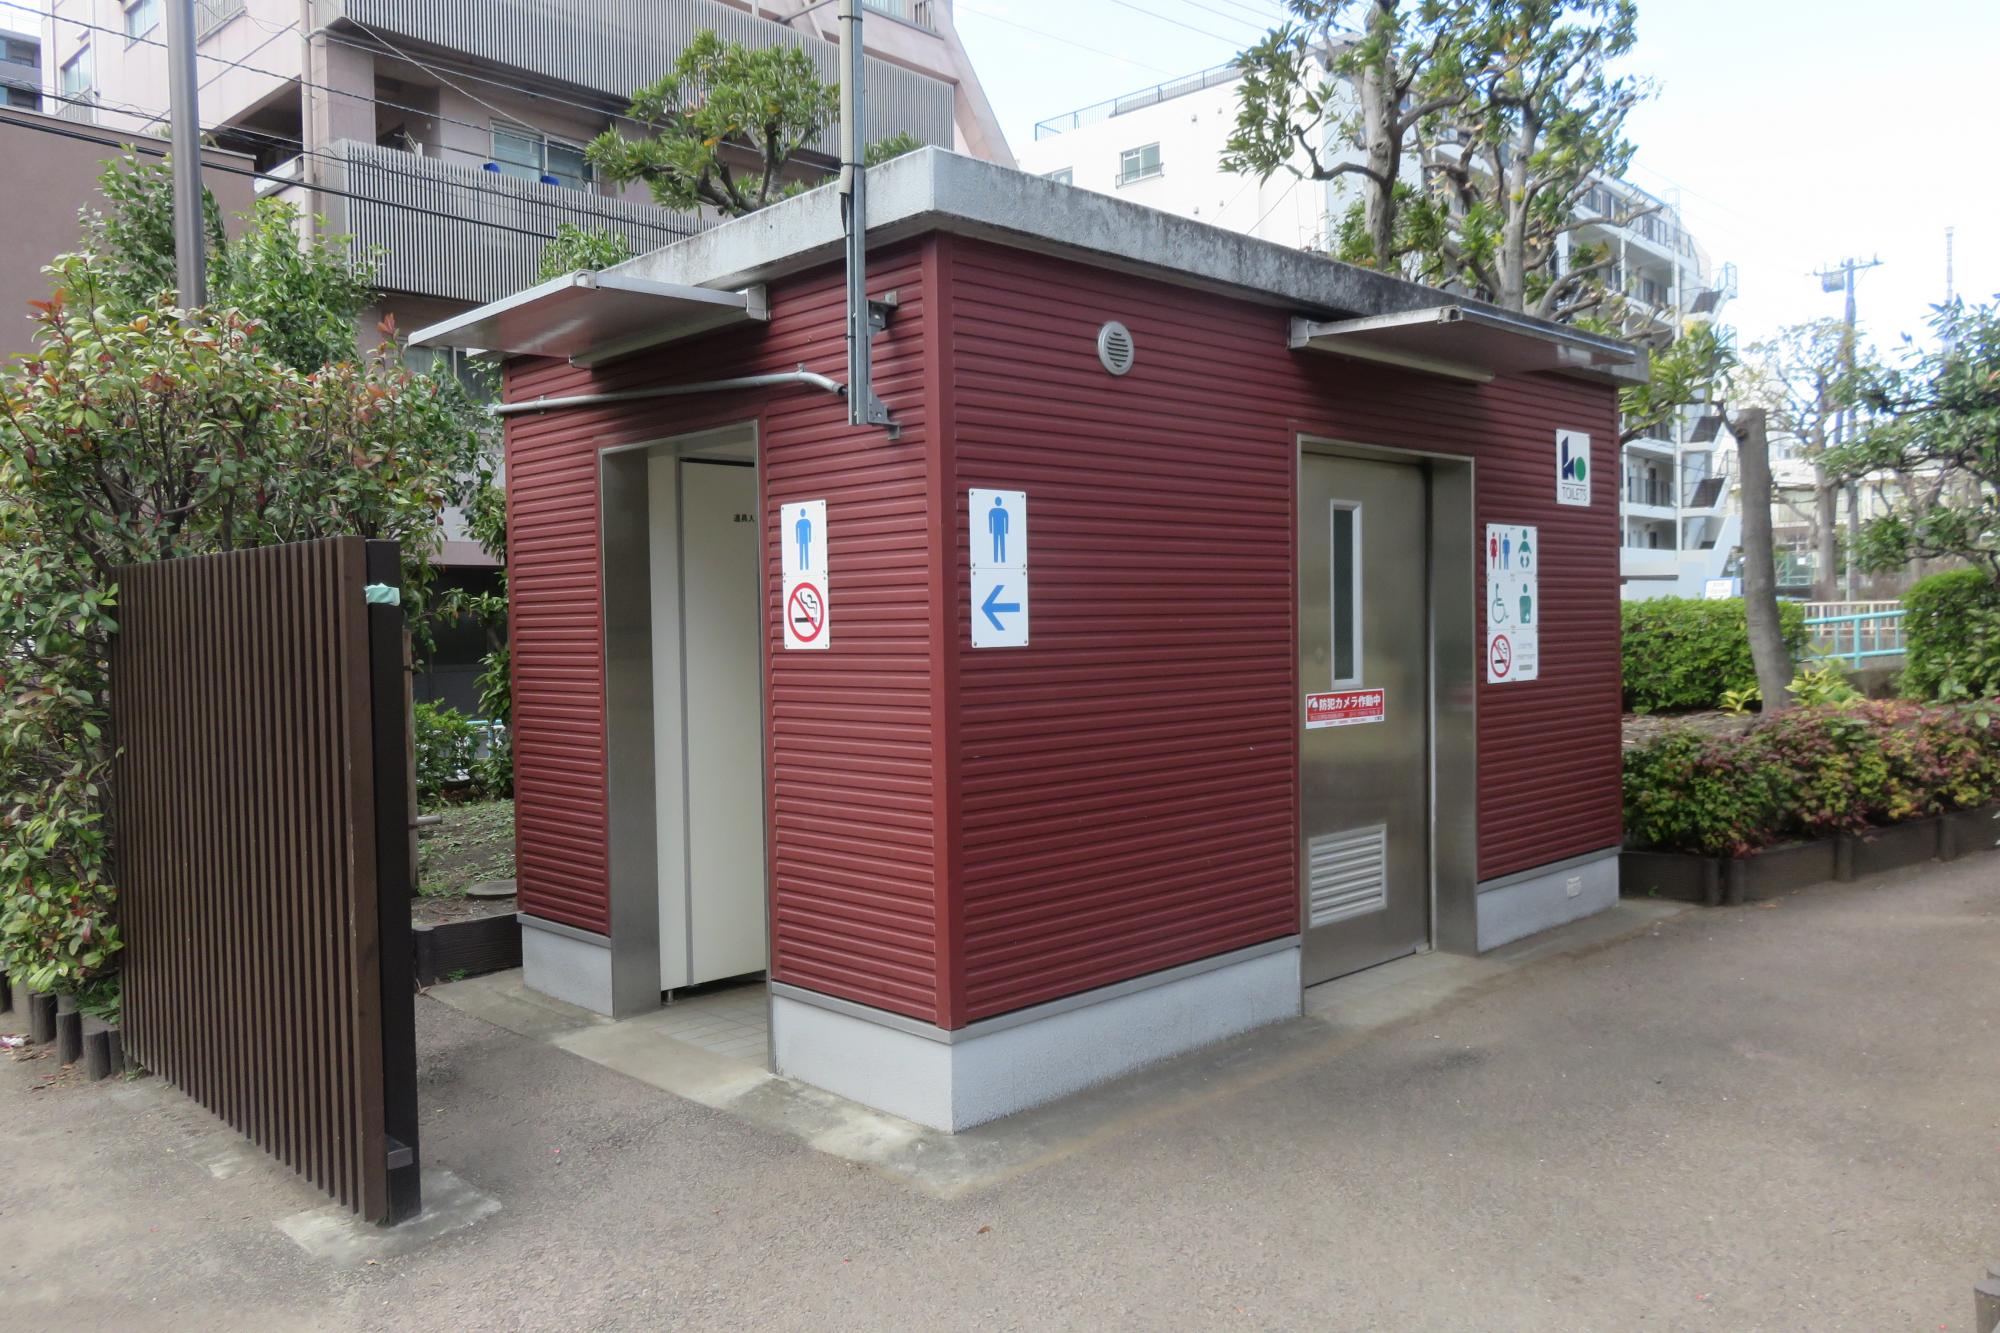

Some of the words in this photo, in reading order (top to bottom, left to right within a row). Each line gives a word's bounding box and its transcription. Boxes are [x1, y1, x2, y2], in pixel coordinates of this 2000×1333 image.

[1562, 486, 1587, 501] TOILETS
[1319, 694, 1381, 711] 防犯カメラ作動中
